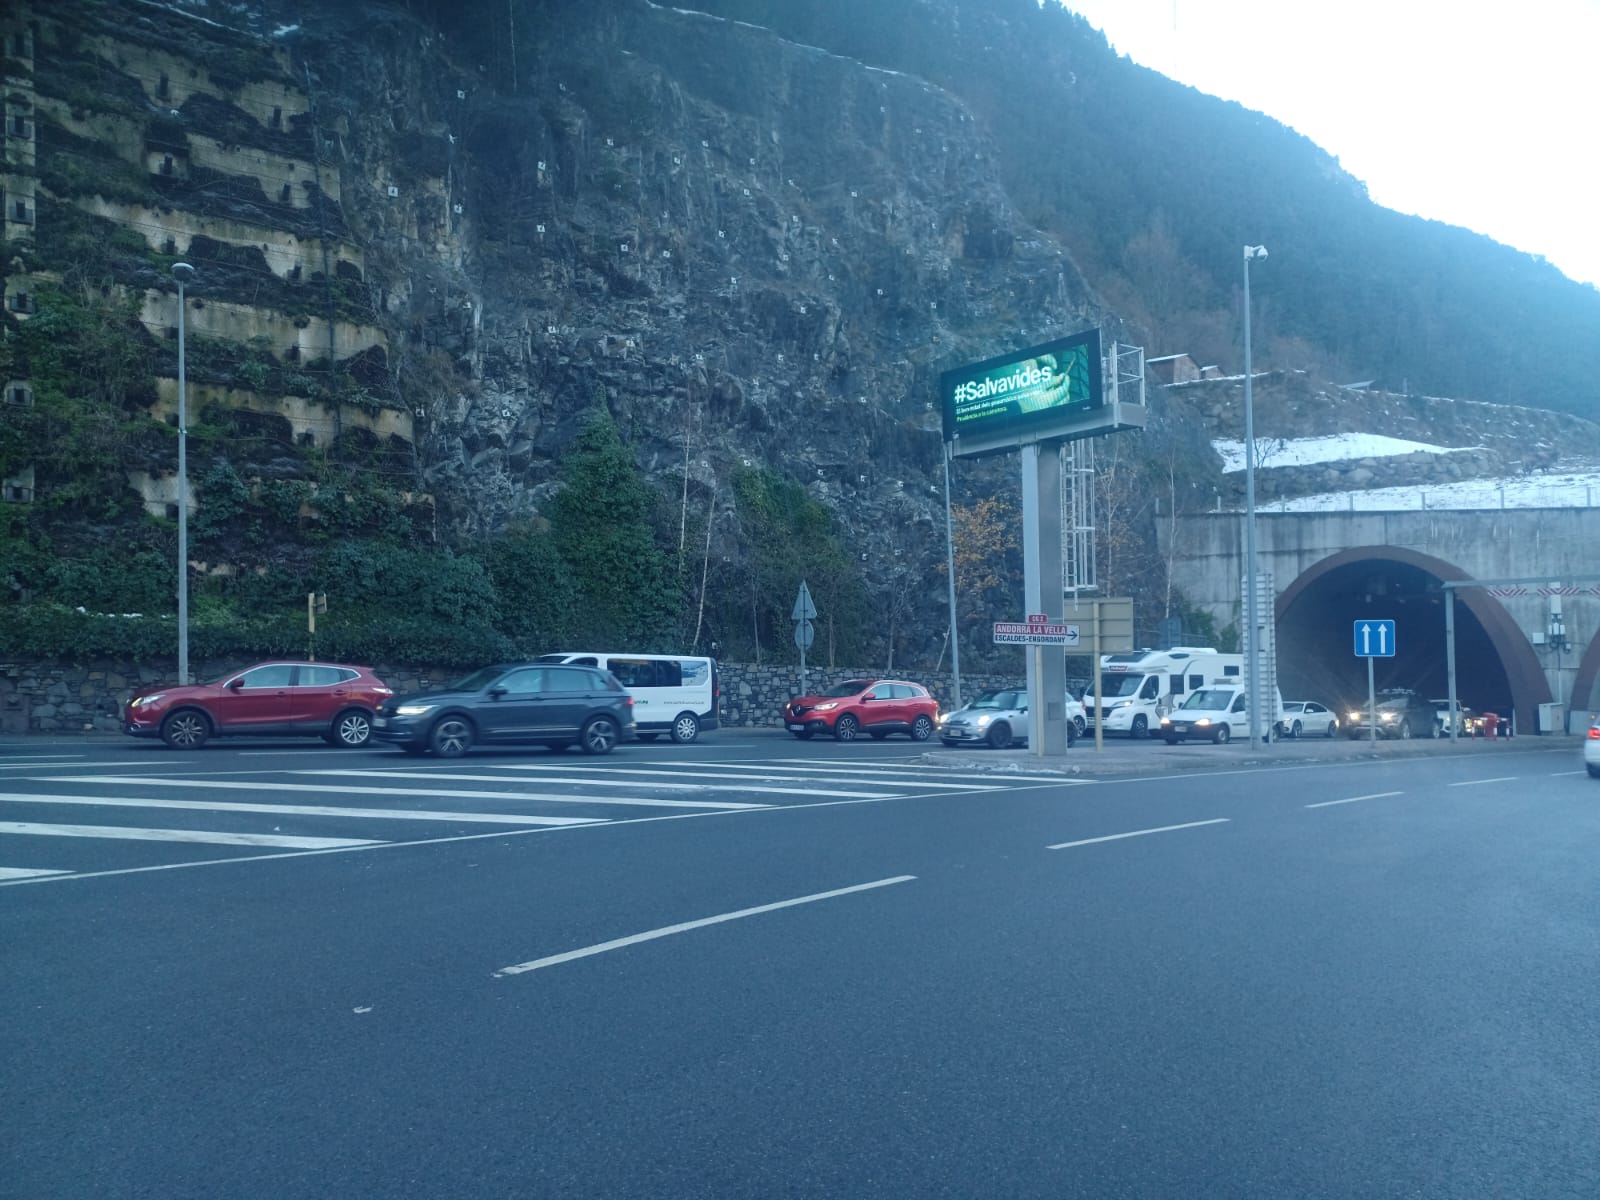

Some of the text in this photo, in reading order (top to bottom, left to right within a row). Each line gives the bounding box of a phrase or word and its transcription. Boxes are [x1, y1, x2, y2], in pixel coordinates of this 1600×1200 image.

[954, 366, 1052, 404] #Salvavides
[996, 625, 1066, 634] ANDORRA LA VELLA
[995, 635, 1066, 643] ESCALDES-ENGORDANY
